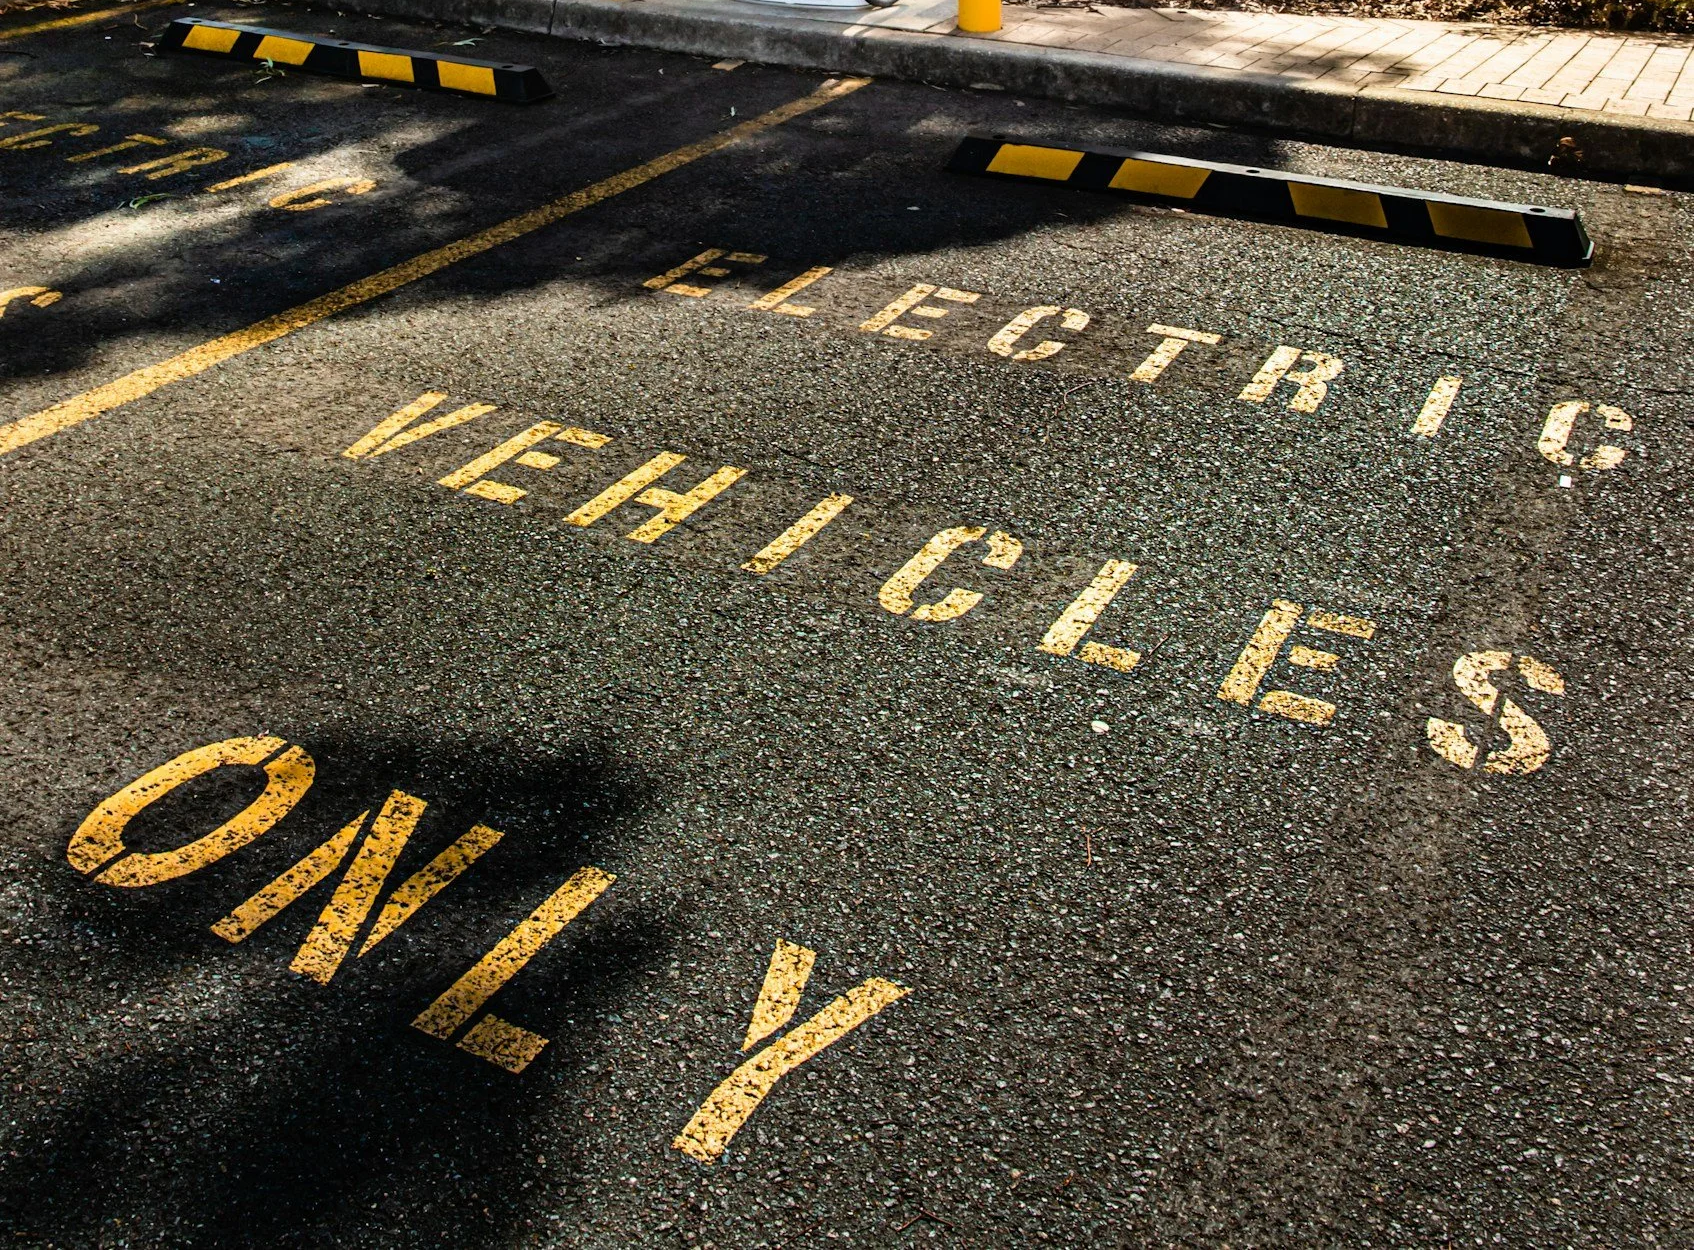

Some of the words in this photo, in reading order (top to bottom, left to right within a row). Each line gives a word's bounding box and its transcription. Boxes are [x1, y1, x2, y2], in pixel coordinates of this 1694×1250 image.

[643, 248, 1635, 471] ELECTRIC
[342, 391, 1567, 775] VEHICLES
[67, 734, 913, 1164] ONLY
